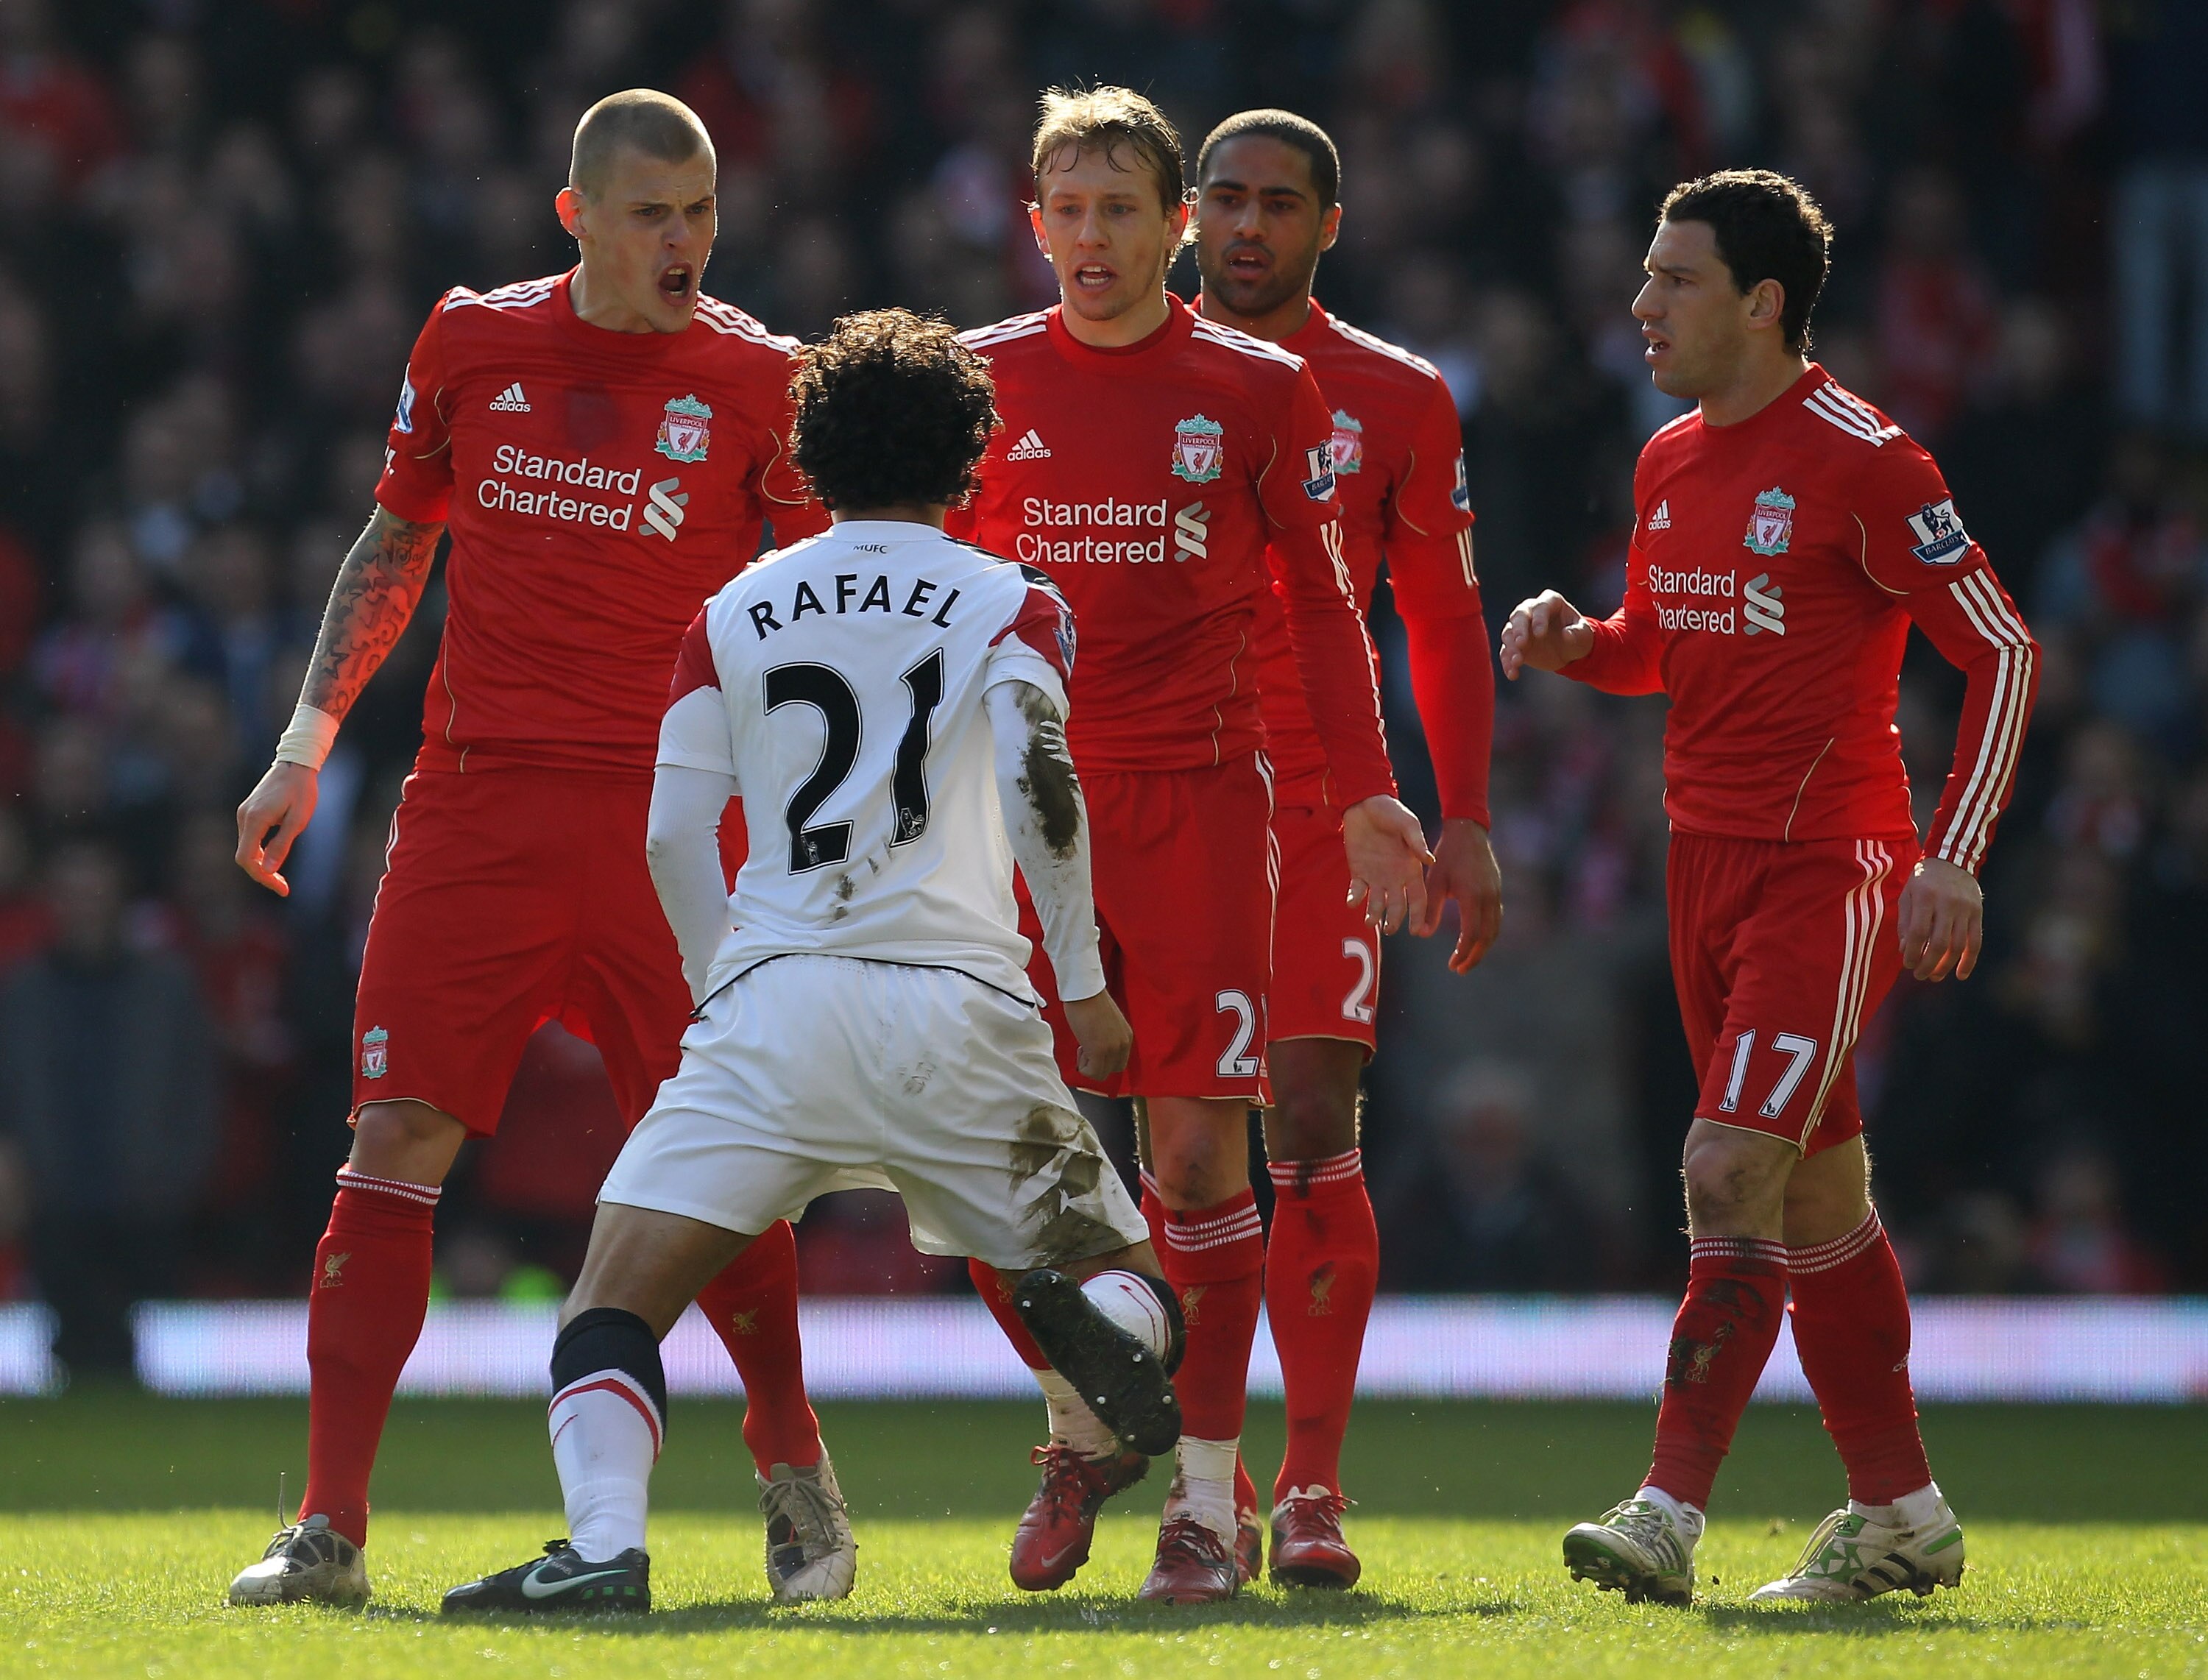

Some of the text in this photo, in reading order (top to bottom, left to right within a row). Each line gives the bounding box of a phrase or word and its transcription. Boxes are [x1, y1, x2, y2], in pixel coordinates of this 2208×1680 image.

[489, 400, 531, 412] adidas
[670, 416, 704, 427] LIVERPOOL
[1007, 448, 1052, 461] adidas
[1182, 437, 1215, 445] LIVERPOOL
[493, 444, 642, 495] Standard
[478, 479, 633, 531] Chartered
[1023, 497, 1167, 527] Standard
[1758, 509, 1786, 519] LIVERPOOL
[853, 544, 888, 554] MUFC
[1016, 534, 1165, 564] Chartered
[1925, 536, 1959, 555] BARCLAYS
[1649, 564, 1735, 598] Standard
[746, 573, 961, 641] RAFAEL
[762, 647, 944, 876] 21
[1341, 936, 1374, 1025] 2
[1215, 988, 1264, 1078] 2
[1718, 1029, 1817, 1119] 17
